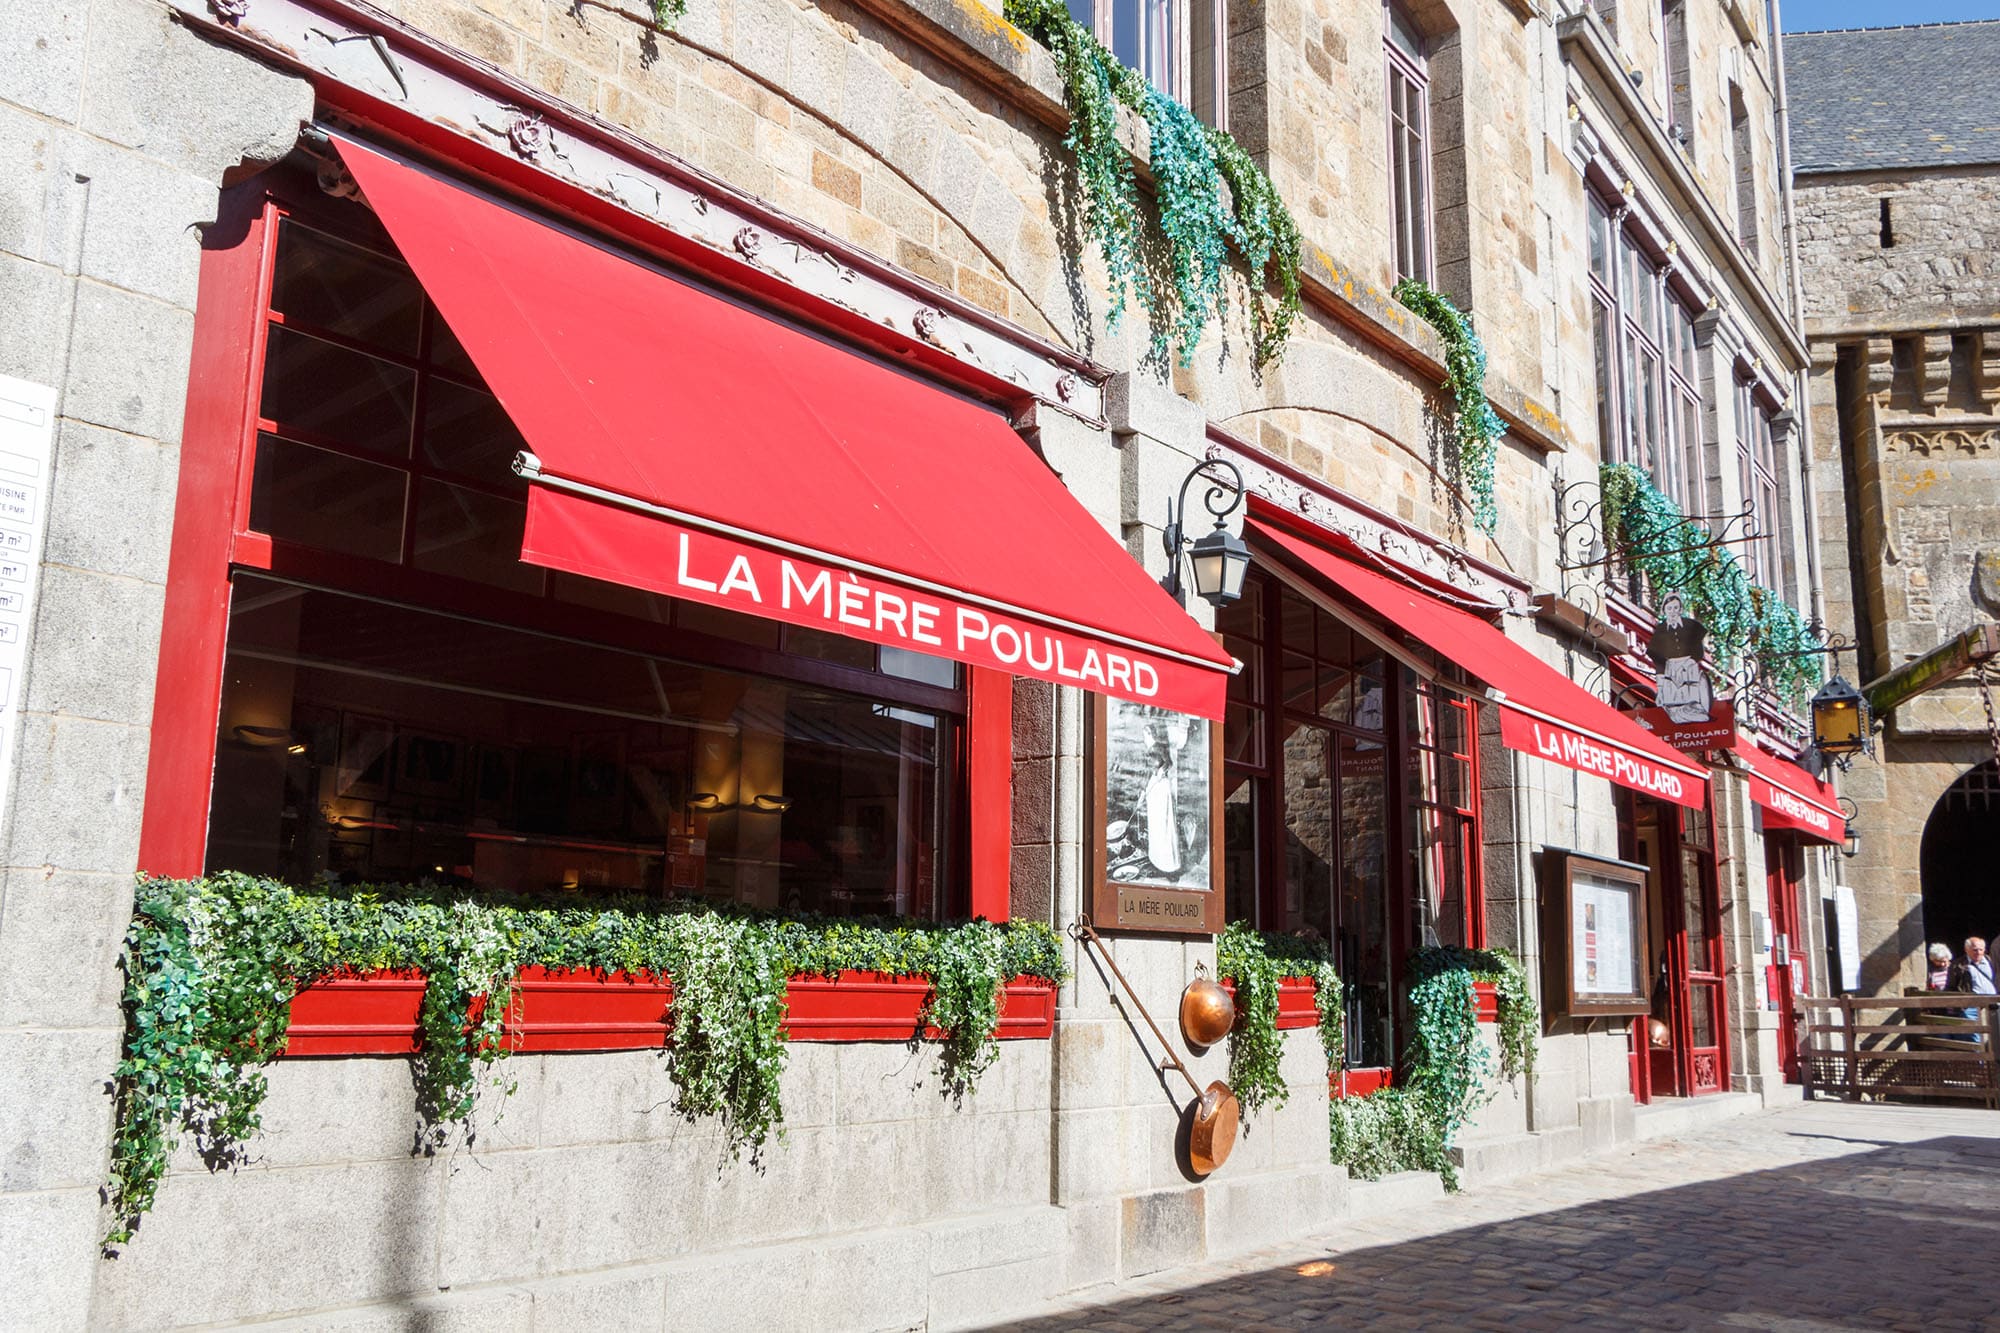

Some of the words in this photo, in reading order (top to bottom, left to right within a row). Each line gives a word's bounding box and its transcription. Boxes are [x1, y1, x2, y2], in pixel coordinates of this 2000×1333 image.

[678, 533, 762, 603] LA
[781, 559, 941, 646] MÈRE
[956, 606, 1159, 697] POULARD
[1674, 729, 1729, 740] POULARD
[1534, 723, 1562, 760] LA
[1562, 733, 1614, 775] MÈRE
[1614, 751, 1683, 798] POULARD
[1800, 801, 1830, 831] POULARD
[1124, 900, 1135, 913] LA
[1139, 896, 1160, 915] MÈRE
[1165, 902, 1199, 917] POULARD
